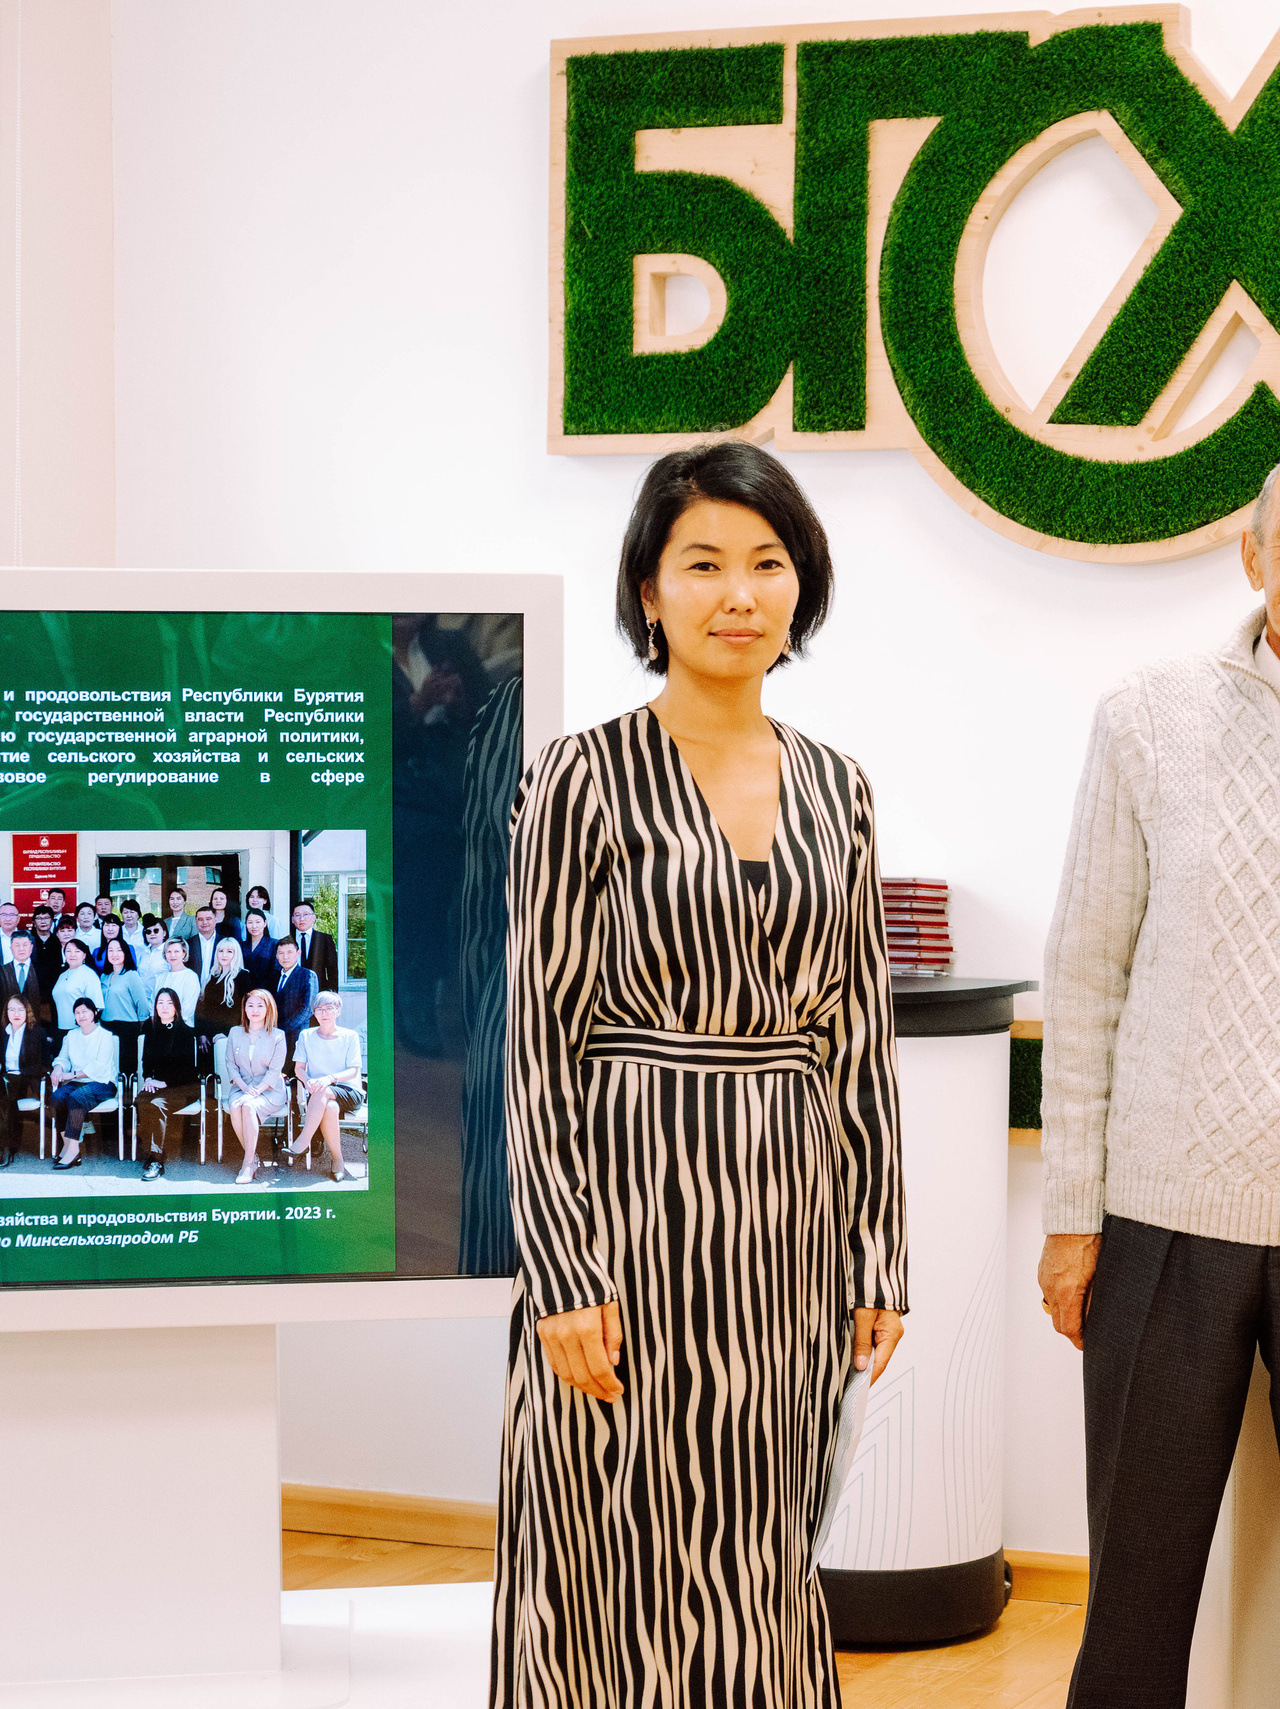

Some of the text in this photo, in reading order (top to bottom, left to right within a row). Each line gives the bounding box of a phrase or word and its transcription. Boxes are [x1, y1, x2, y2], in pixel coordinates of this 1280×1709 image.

[3, 687, 365, 706] и продовольствия Республики Бурятия
[15, 708, 365, 726] государственной власти Республики
[28, 728, 177, 746] государственной
[188, 728, 268, 746] аграрной
[279, 731, 365, 746] политики,
[47, 752, 136, 763] сельского
[152, 748, 241, 763] хозяйства
[258, 752, 269, 763] и
[285, 752, 365, 763] сельских
[88, 772, 219, 787] регулирование
[260, 772, 271, 783] в
[310, 769, 365, 786] сфере
[62, 1214, 73, 1225] и
[77, 1211, 207, 1228] продовольствия
[211, 1208, 281, 1225] Бурятии.
[285, 1206, 322, 1220] 2023
[326, 1208, 337, 1219] г.
[15, 1231, 174, 1249] Минсельхозпродом
[178, 1229, 199, 1244] РБ
